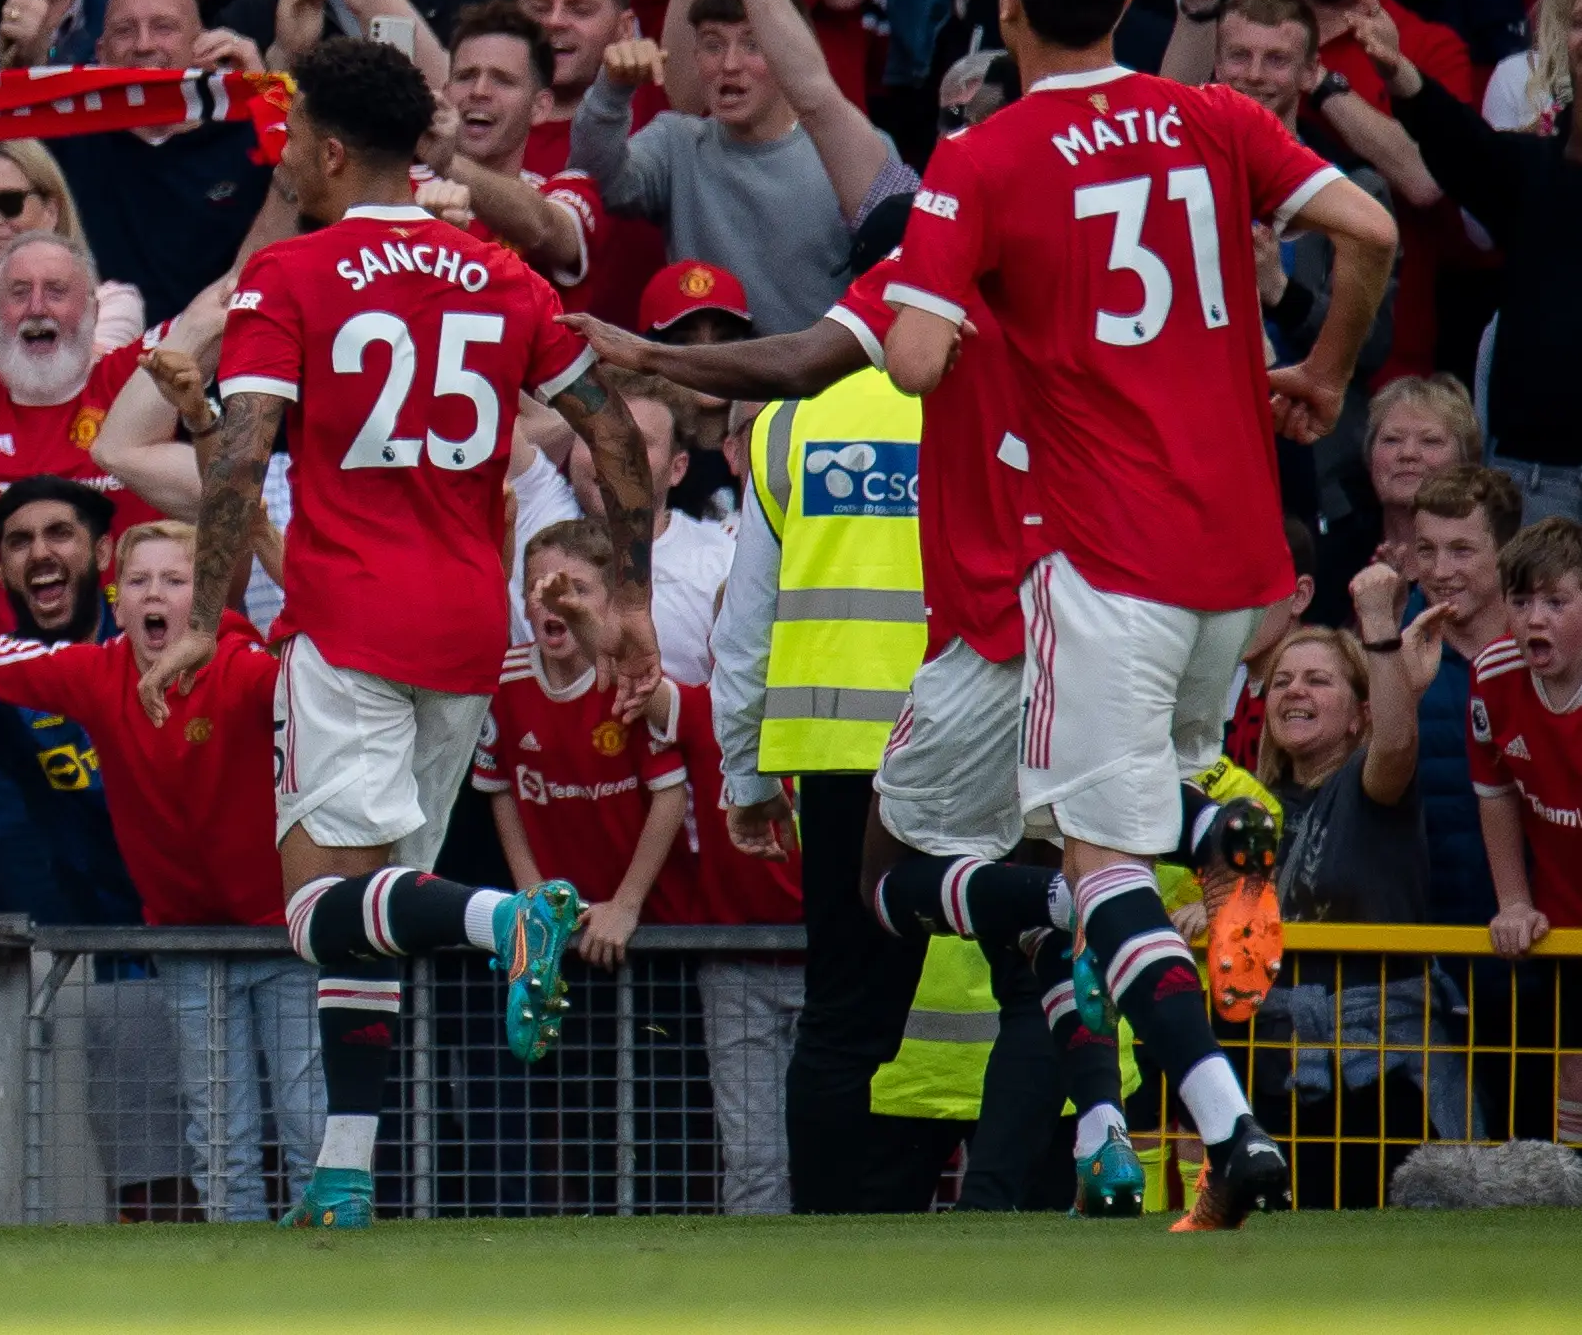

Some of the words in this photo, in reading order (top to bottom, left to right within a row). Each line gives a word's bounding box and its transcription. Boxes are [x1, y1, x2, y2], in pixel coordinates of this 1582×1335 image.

[1051, 104, 1183, 167] MATIĆ
[336, 240, 489, 293] SANCHO
[1073, 164, 1231, 347] 31
[331, 309, 505, 471] 25
